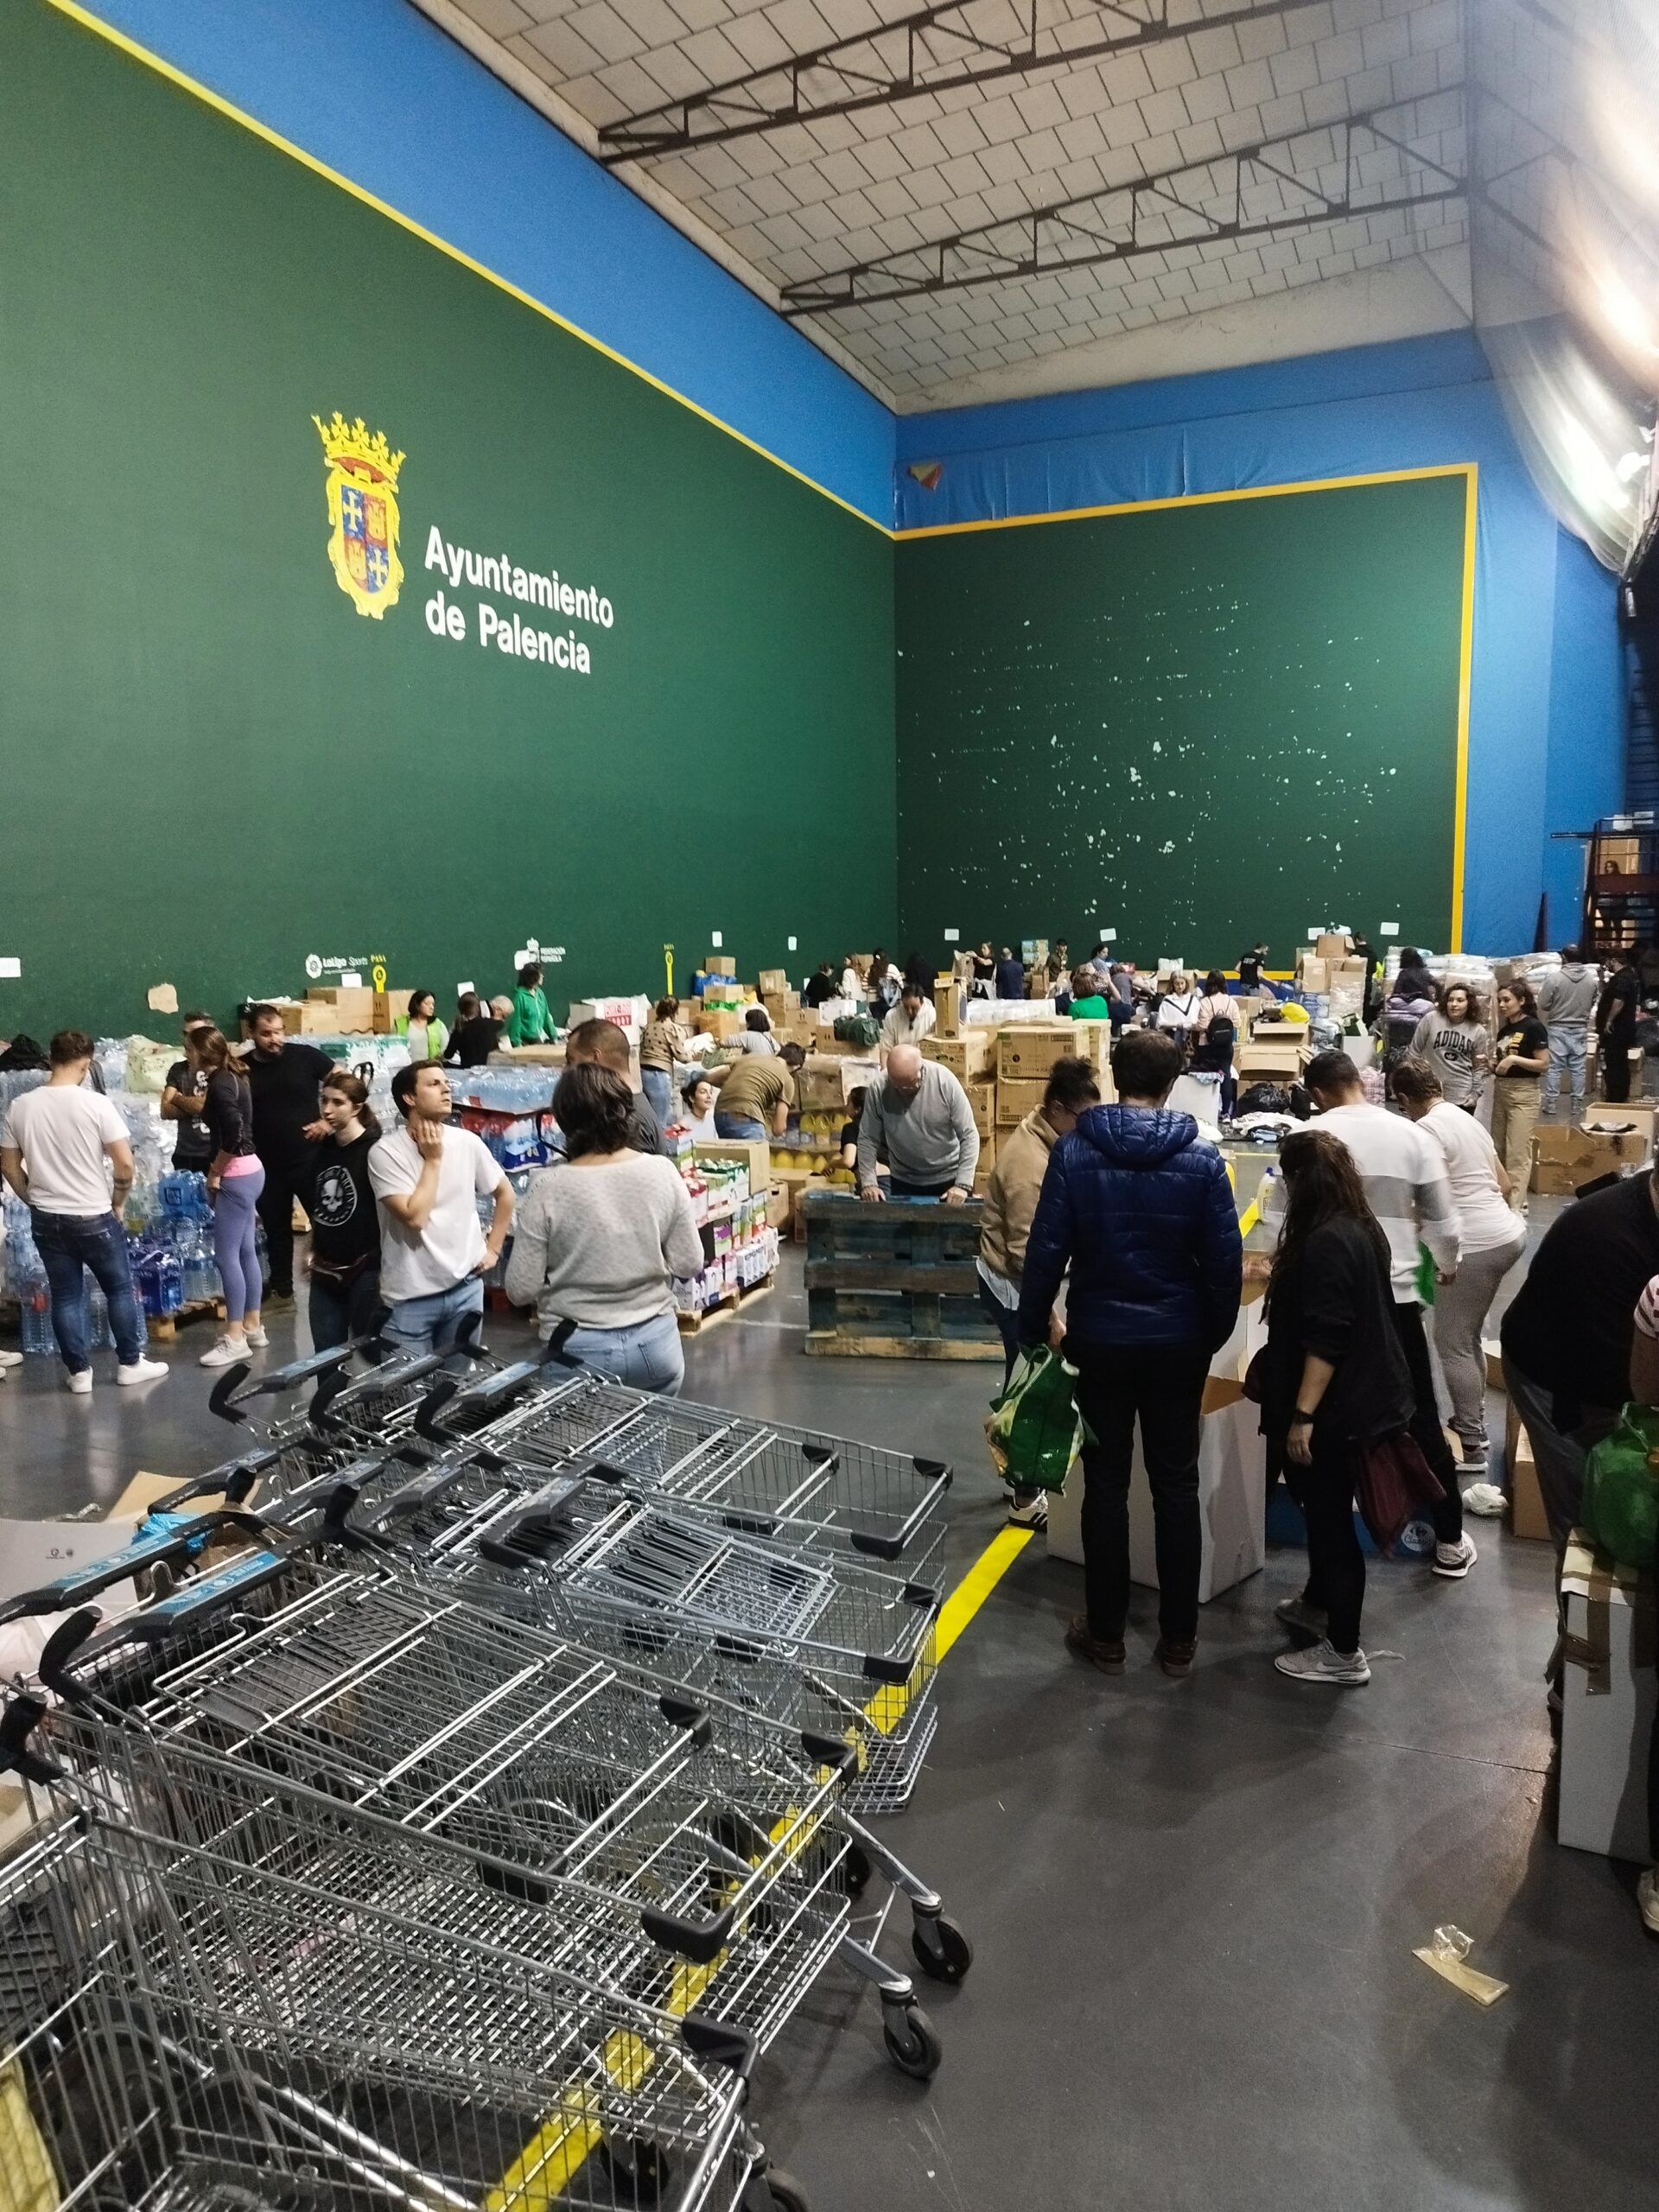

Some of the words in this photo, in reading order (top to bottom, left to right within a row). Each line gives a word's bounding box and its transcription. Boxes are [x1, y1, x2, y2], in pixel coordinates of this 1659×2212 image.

[425, 525, 614, 628] Ayuntamiento
[425, 590, 466, 640] de
[479, 603, 591, 674] Palencia
[1433, 1030, 1475, 1055] ADIDAS
